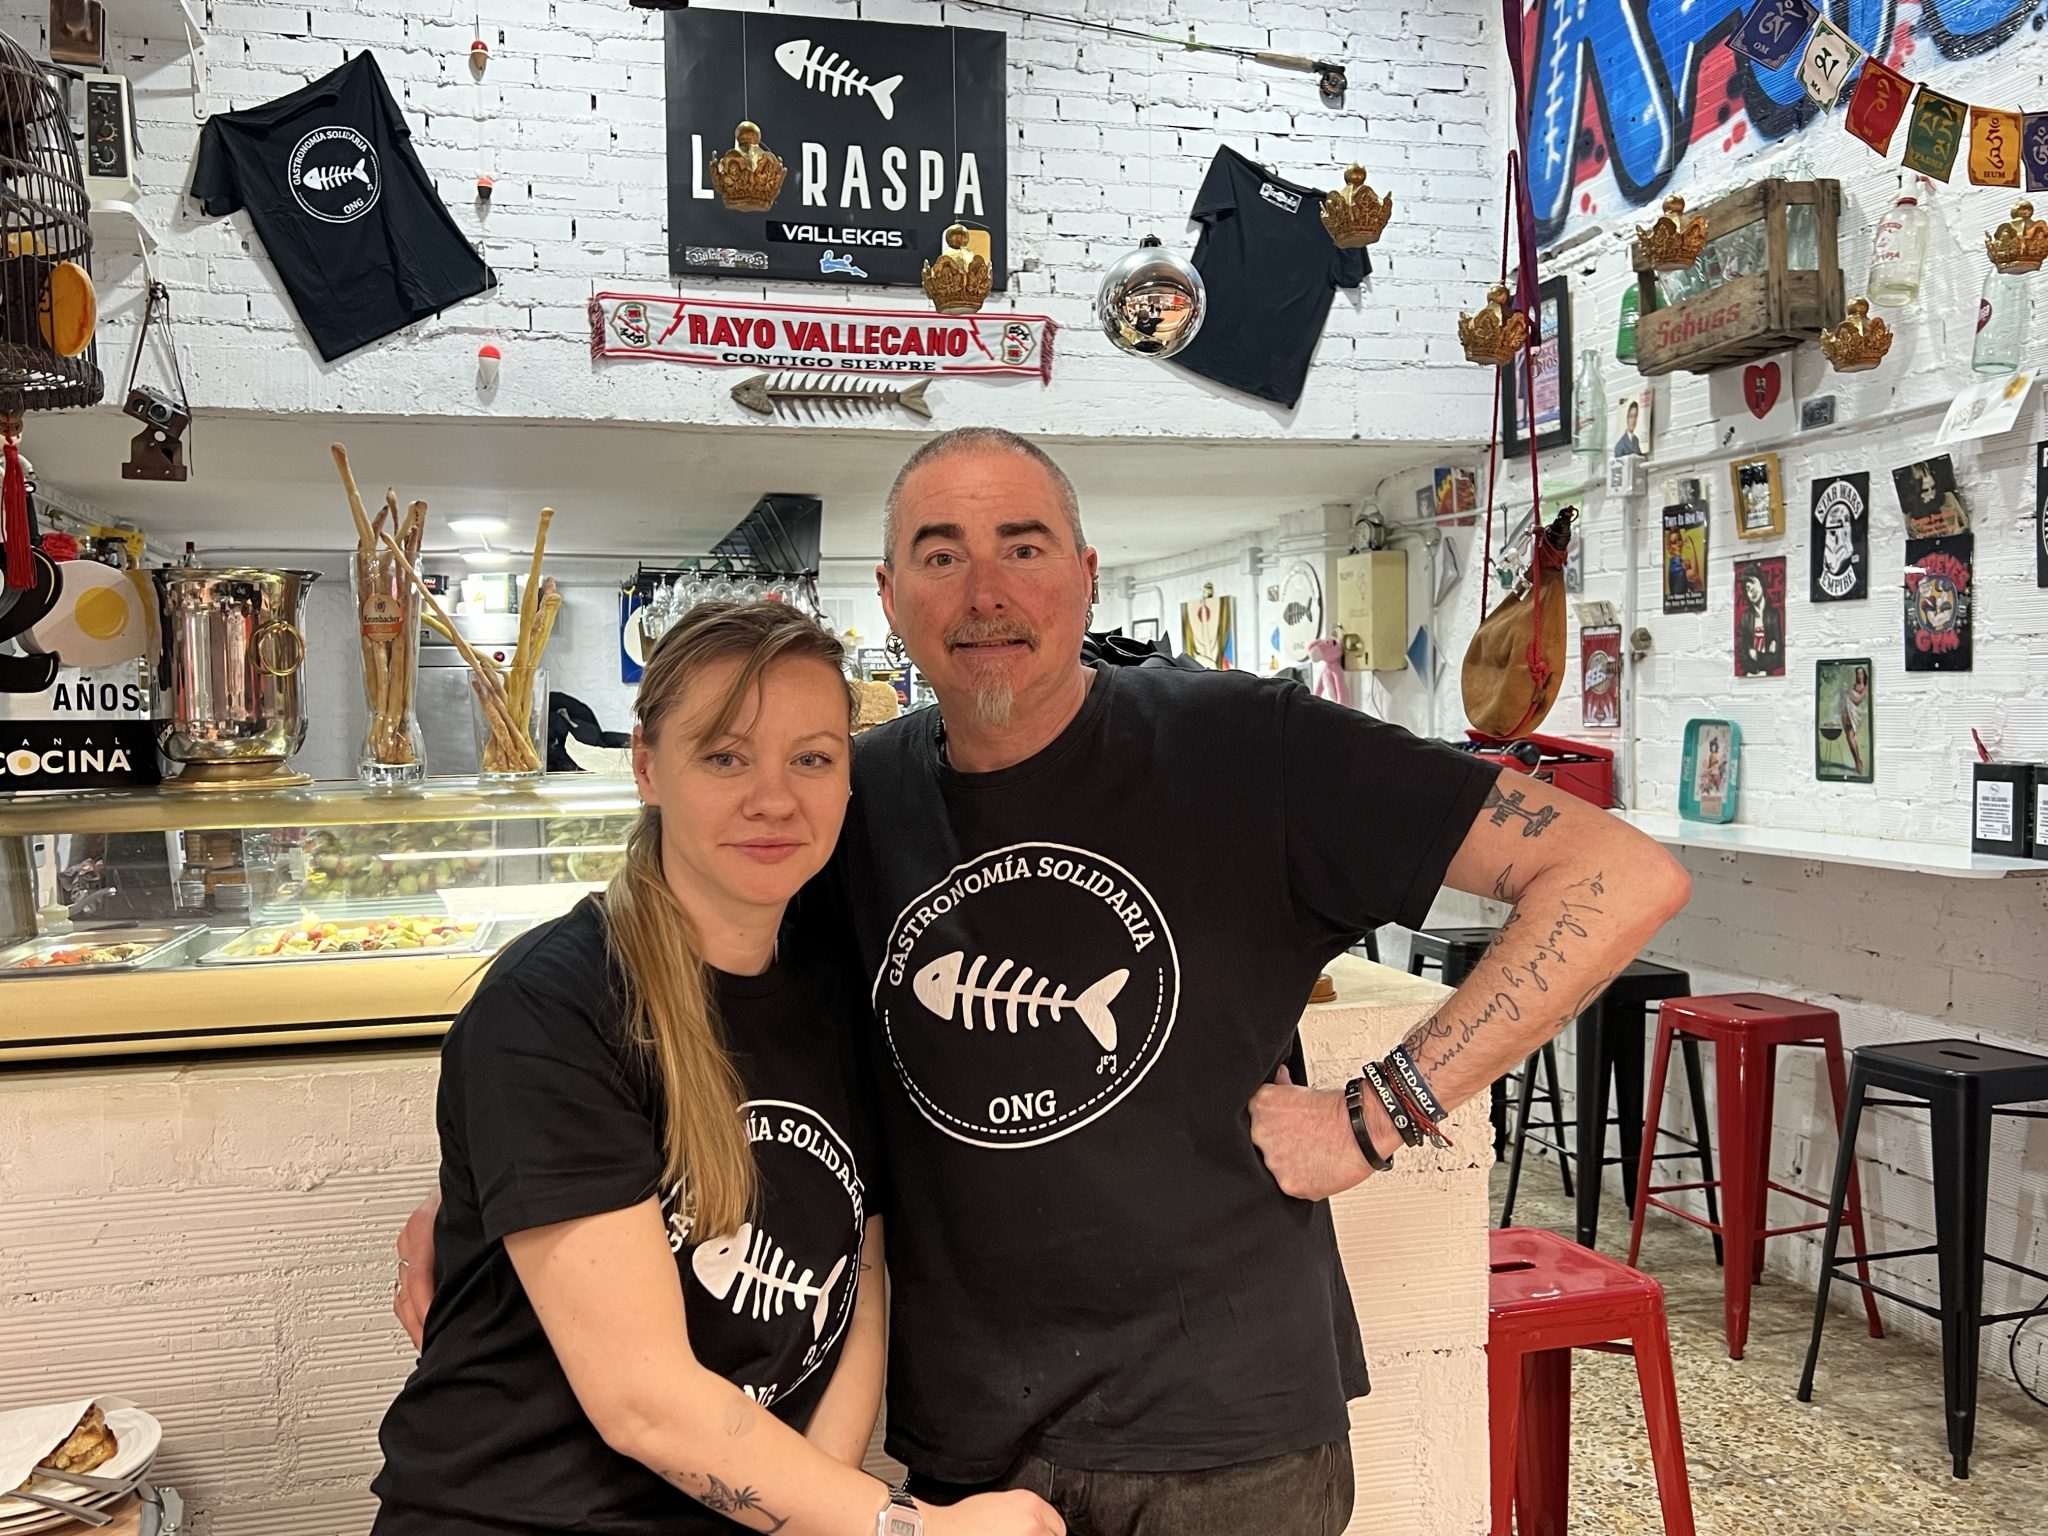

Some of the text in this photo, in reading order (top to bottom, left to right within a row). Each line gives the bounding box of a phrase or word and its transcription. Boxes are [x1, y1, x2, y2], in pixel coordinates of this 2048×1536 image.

[1752, 41, 1770, 55] OM
[1810, 80, 1822, 96] MA
[292, 131, 327, 186] GASTRONOMÍA
[801, 141, 985, 217] RASPA
[1984, 170, 2006, 179] HUM
[343, 197, 364, 214] ONG
[782, 223, 903, 248] VALLEKAS
[687, 313, 777, 349] RAYO
[781, 318, 969, 358] VALLECANO
[1653, 302, 1742, 353] Schuss
[721, 351, 937, 372] CONTIGO SIEMPRE
[1839, 483, 1862, 516] WARS
[1822, 568, 1854, 594] EMPIRE
[364, 614, 401, 624] Krombacher
[1915, 629, 1960, 654] GYM
[53, 677, 140, 711] AÑOS
[21, 737, 120, 746] ANAL
[0, 749, 132, 776] OCINA
[889, 854, 1156, 987] GASTRONOMÍA SOLIDARIA
[1364, 1063, 1397, 1113] SOLIDARIA
[1392, 1051, 1436, 1115] SOLIDARIA
[988, 1089, 1057, 1124] ONG
[743, 1382, 778, 1409] NG
